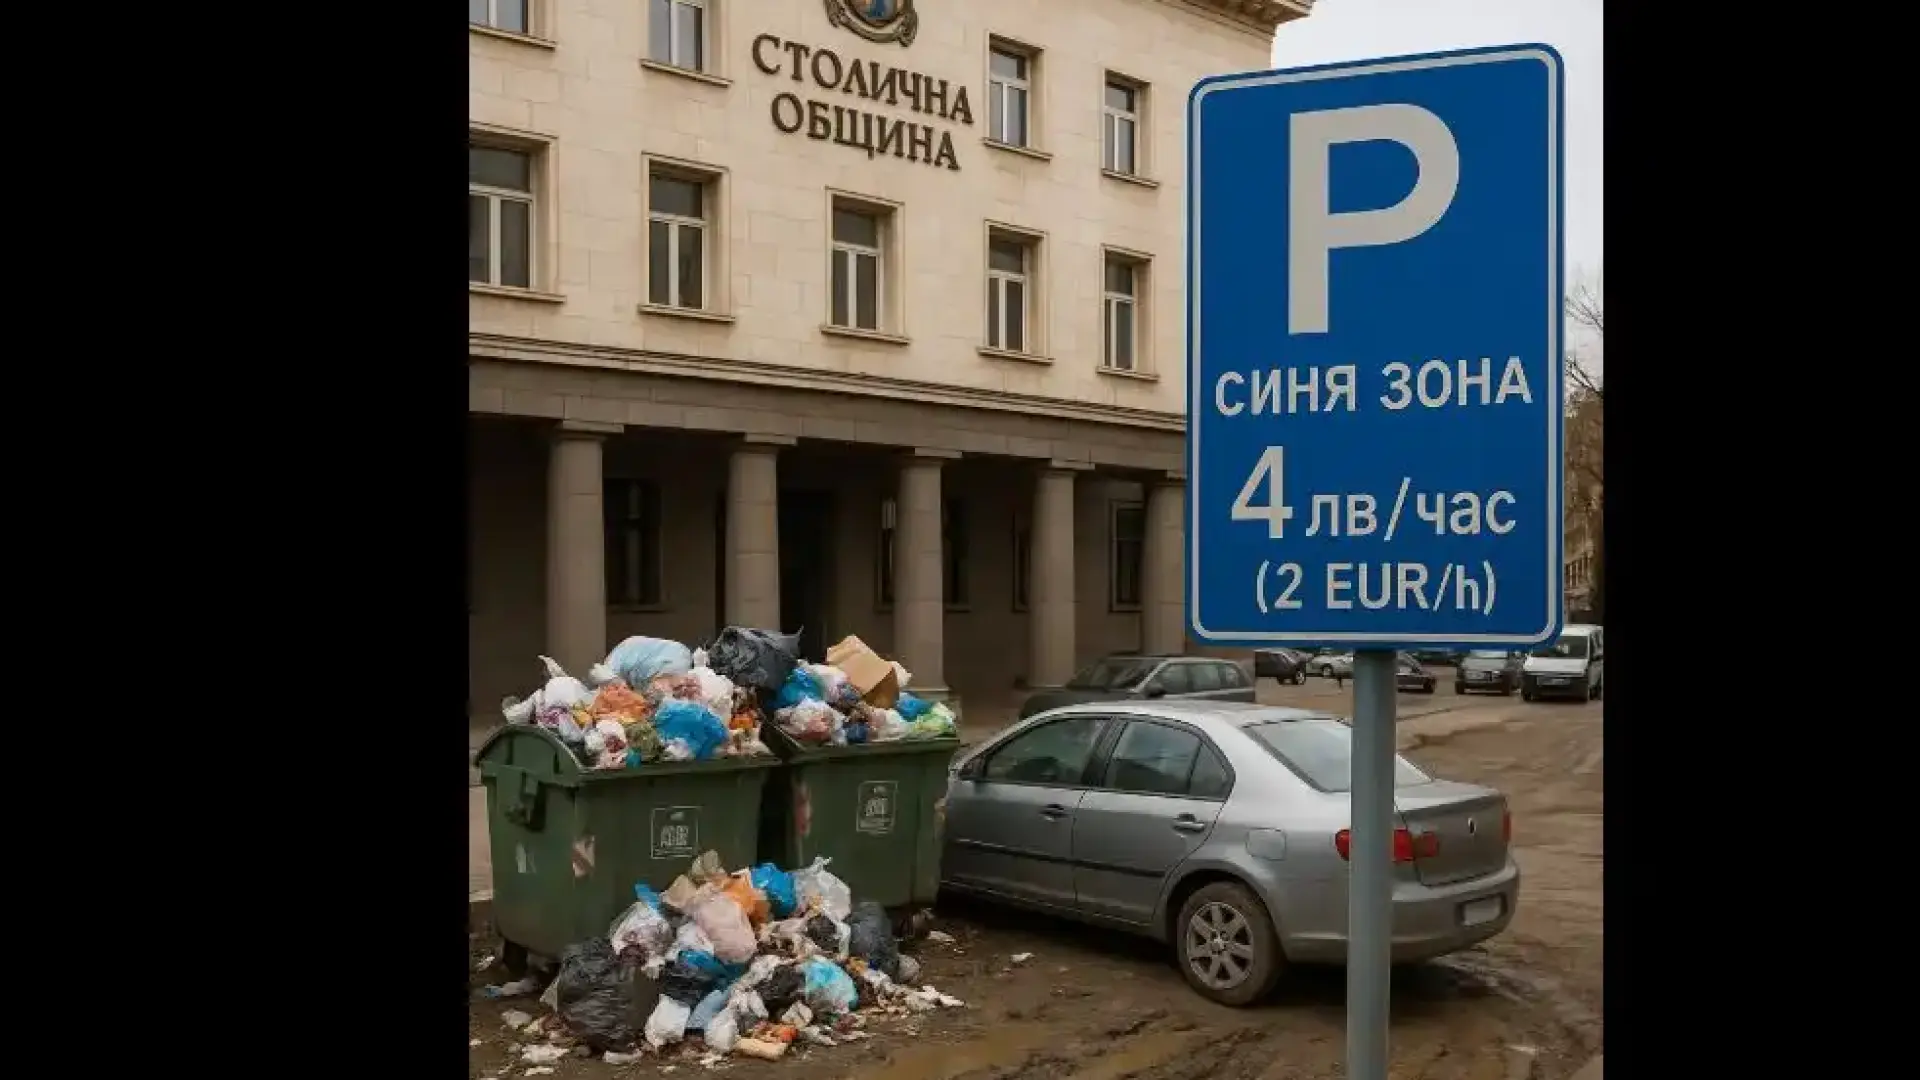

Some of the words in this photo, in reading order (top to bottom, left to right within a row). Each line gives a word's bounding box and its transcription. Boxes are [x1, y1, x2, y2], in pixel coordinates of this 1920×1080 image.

[752, 33, 974, 125] СТОЛИЧНА
[771, 92, 961, 171] ОБЩИНА
[1289, 104, 1459, 333] P
[1216, 365, 1355, 415] СИНЯ
[1380, 358, 1531, 409] ЗОНА
[1232, 446, 1292, 538] 4
[1306, 478, 1515, 540] лв/час
[1257, 562, 1302, 613] (2
[1328, 562, 1495, 614] EUR/h)
